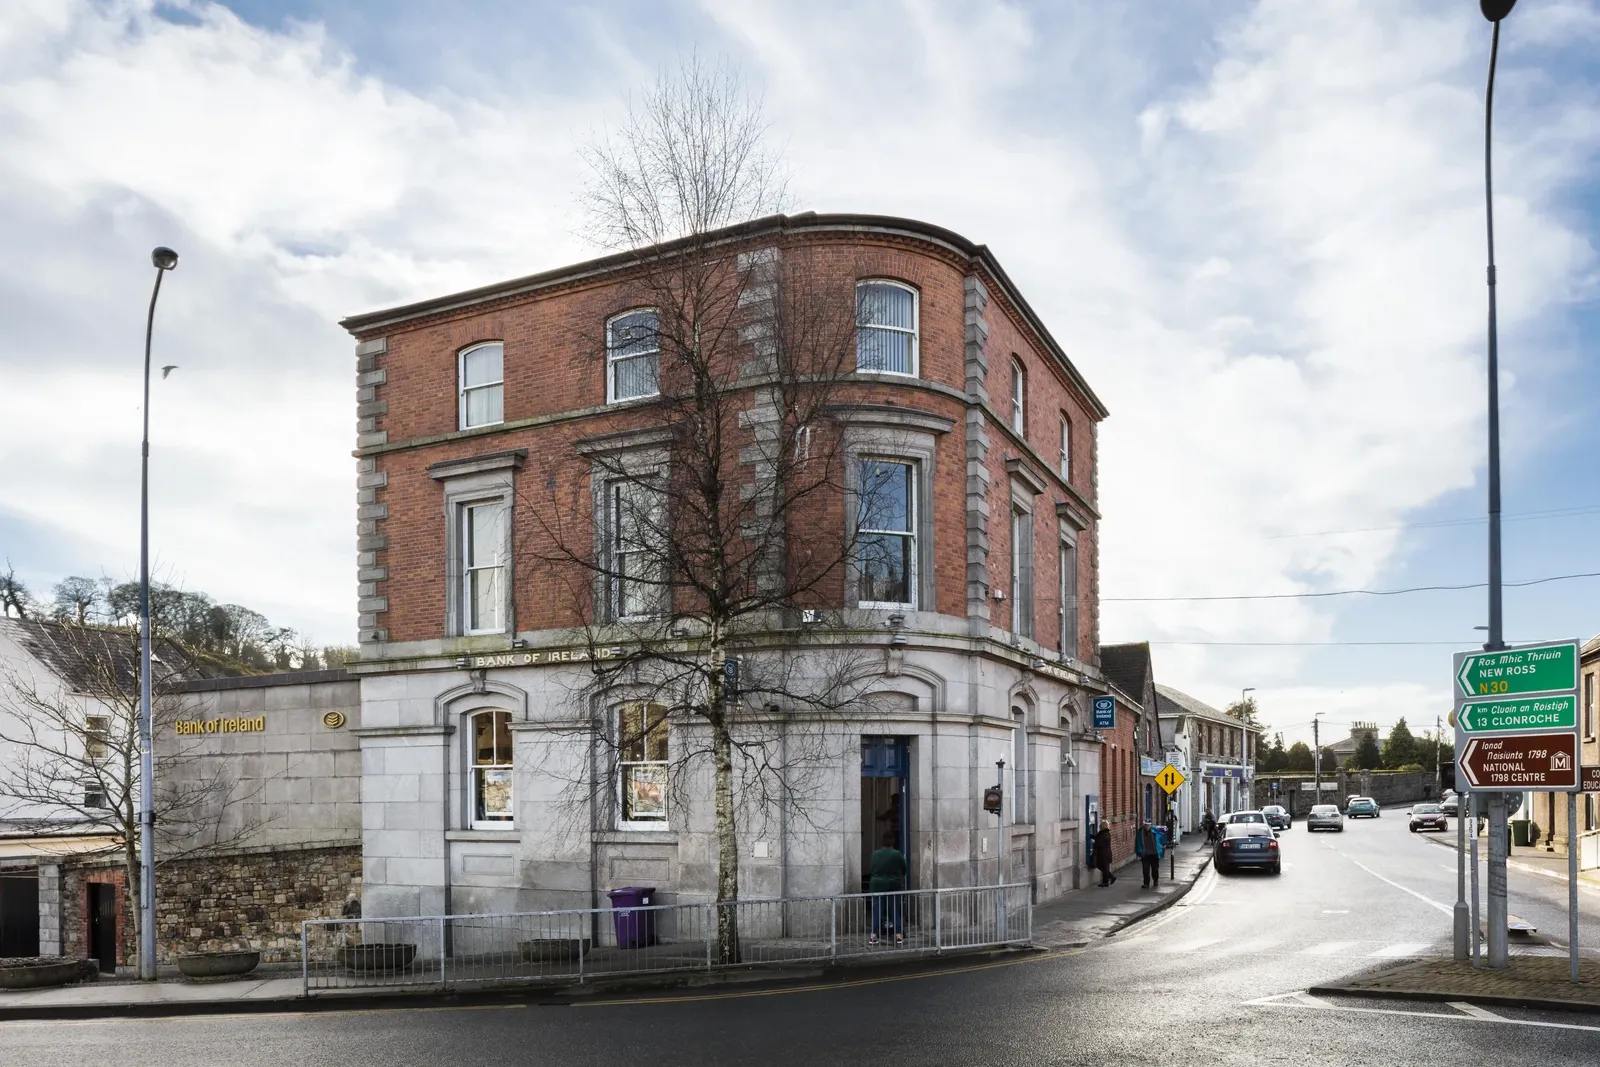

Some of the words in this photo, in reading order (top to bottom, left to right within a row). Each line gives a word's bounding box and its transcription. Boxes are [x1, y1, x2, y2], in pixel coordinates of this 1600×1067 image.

[476, 655, 515, 667] BANK
[523, 653, 541, 663] OF
[1478, 657, 1496, 667] Ros
[1499, 654, 1523, 665] Mhic
[1479, 668, 1503, 678] NEW
[1506, 664, 1537, 676] ROSS
[1491, 704, 1516, 715] Cluain
[1519, 705, 1530, 713] an
[175, 720, 205, 734] Bank
[206, 718, 219, 733] of
[221, 715, 265, 732] Ireland
[1477, 717, 1488, 727] 13
[1491, 713, 1560, 726] CLONROCHE
[1481, 740, 1504, 750] Ionad
[1528, 749, 1547, 760] 1798
[1482, 762, 1526, 772] NATIONAL
[1490, 773, 1509, 782] 1798
[1511, 772, 1546, 782] CENTRE
[1591, 769, 1600, 779] CO
